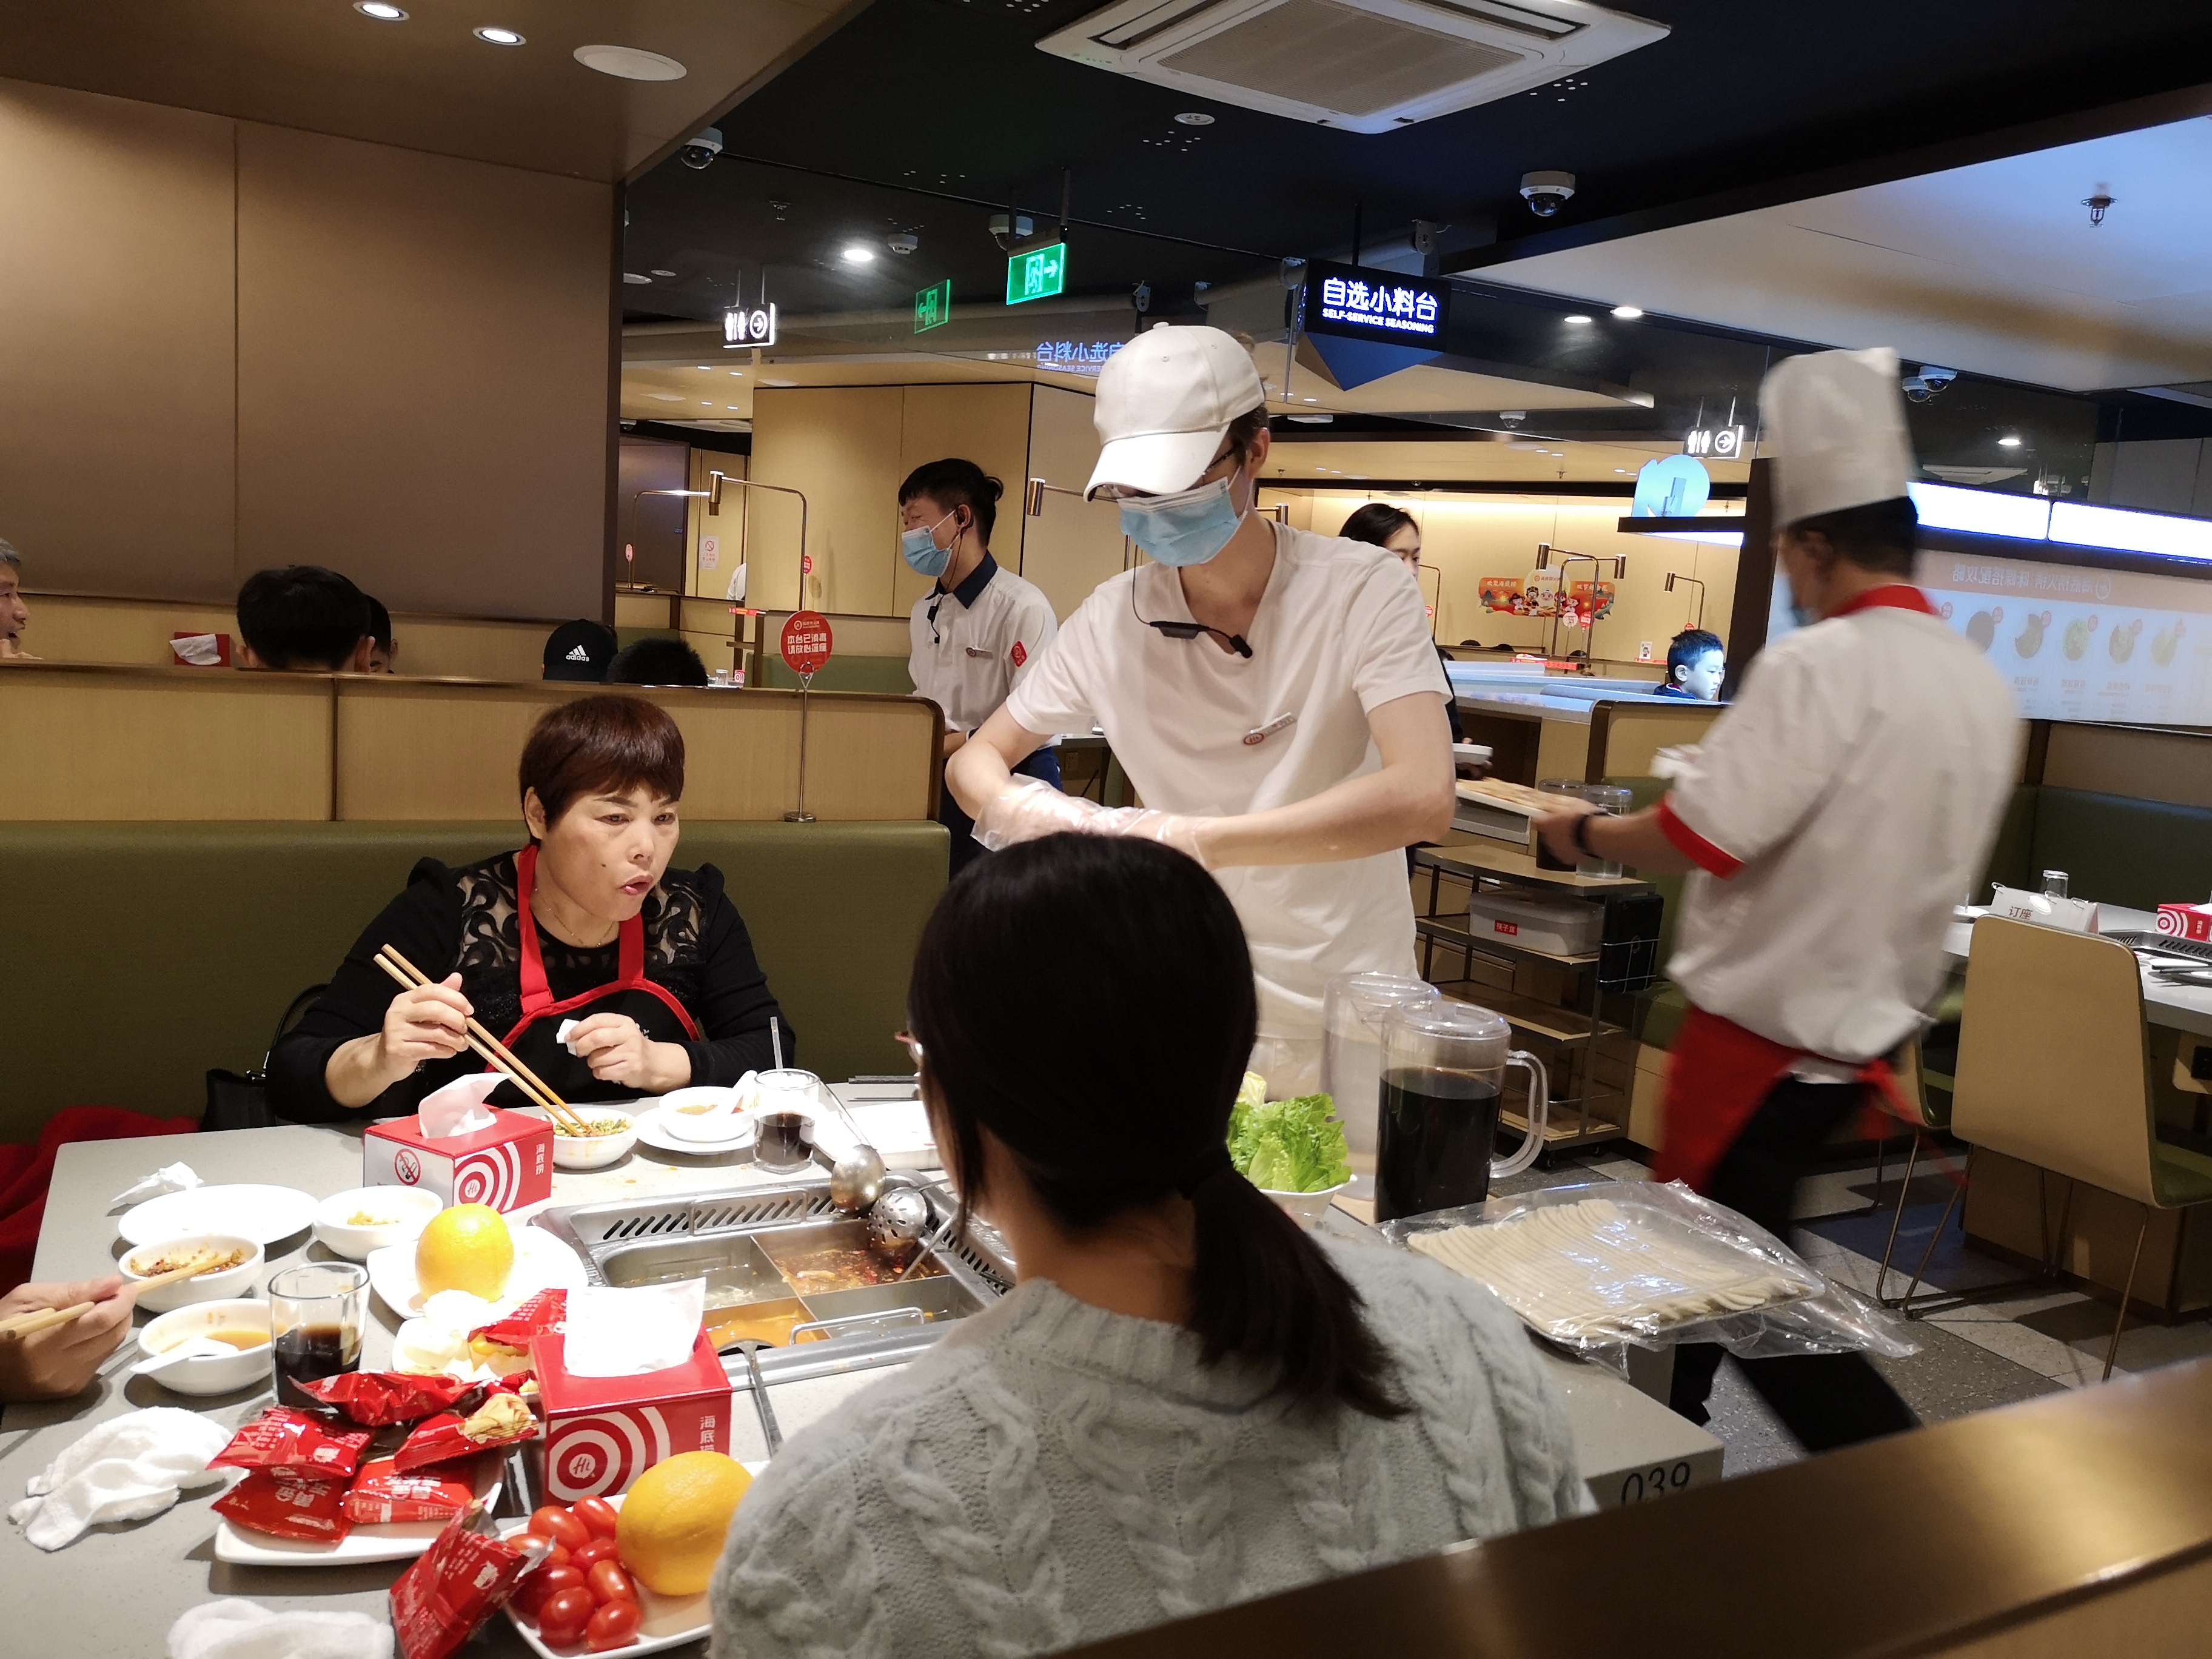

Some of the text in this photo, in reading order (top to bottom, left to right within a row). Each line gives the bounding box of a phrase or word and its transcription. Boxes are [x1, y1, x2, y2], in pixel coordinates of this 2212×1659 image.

[1323, 276, 1438, 320] 自选小料台
[1322, 307, 1435, 333] SELF-SERVICE SEASONING
[566, 654, 589, 662] adidas
[2009, 905, 2033, 920] 订座
[535, 1142, 546, 1176] 海底捞
[572, 1456, 591, 1475] Hi
